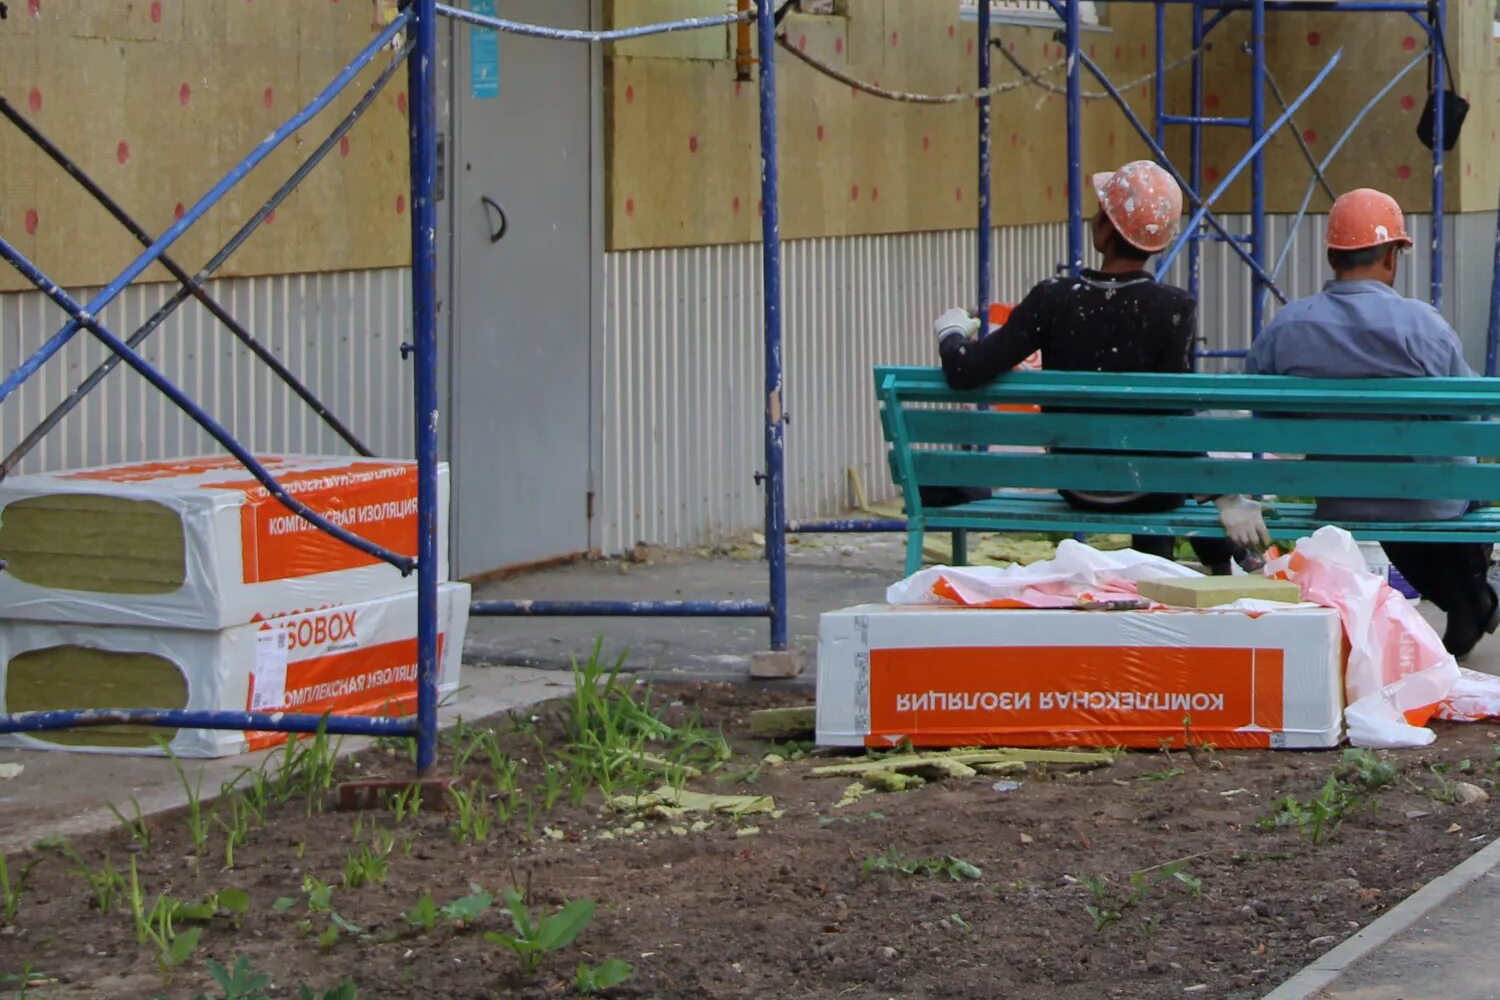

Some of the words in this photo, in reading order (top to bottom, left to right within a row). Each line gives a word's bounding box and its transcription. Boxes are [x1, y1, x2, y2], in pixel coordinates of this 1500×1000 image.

[269, 507, 356, 536] КОМПСНАЯ
[359, 497, 418, 525] ИЗОЛЯЦИЯ
[280, 610, 357, 650] SOBOX
[284, 673, 366, 708] ОМПЛЕКСНАЯ
[366, 663, 418, 689] ИЗОЛЯЦИ
[896, 690, 1031, 712] ИЗОЛЯЦИЯ
[1039, 691, 1224, 711] КОМПЛЕКСНАЯ
